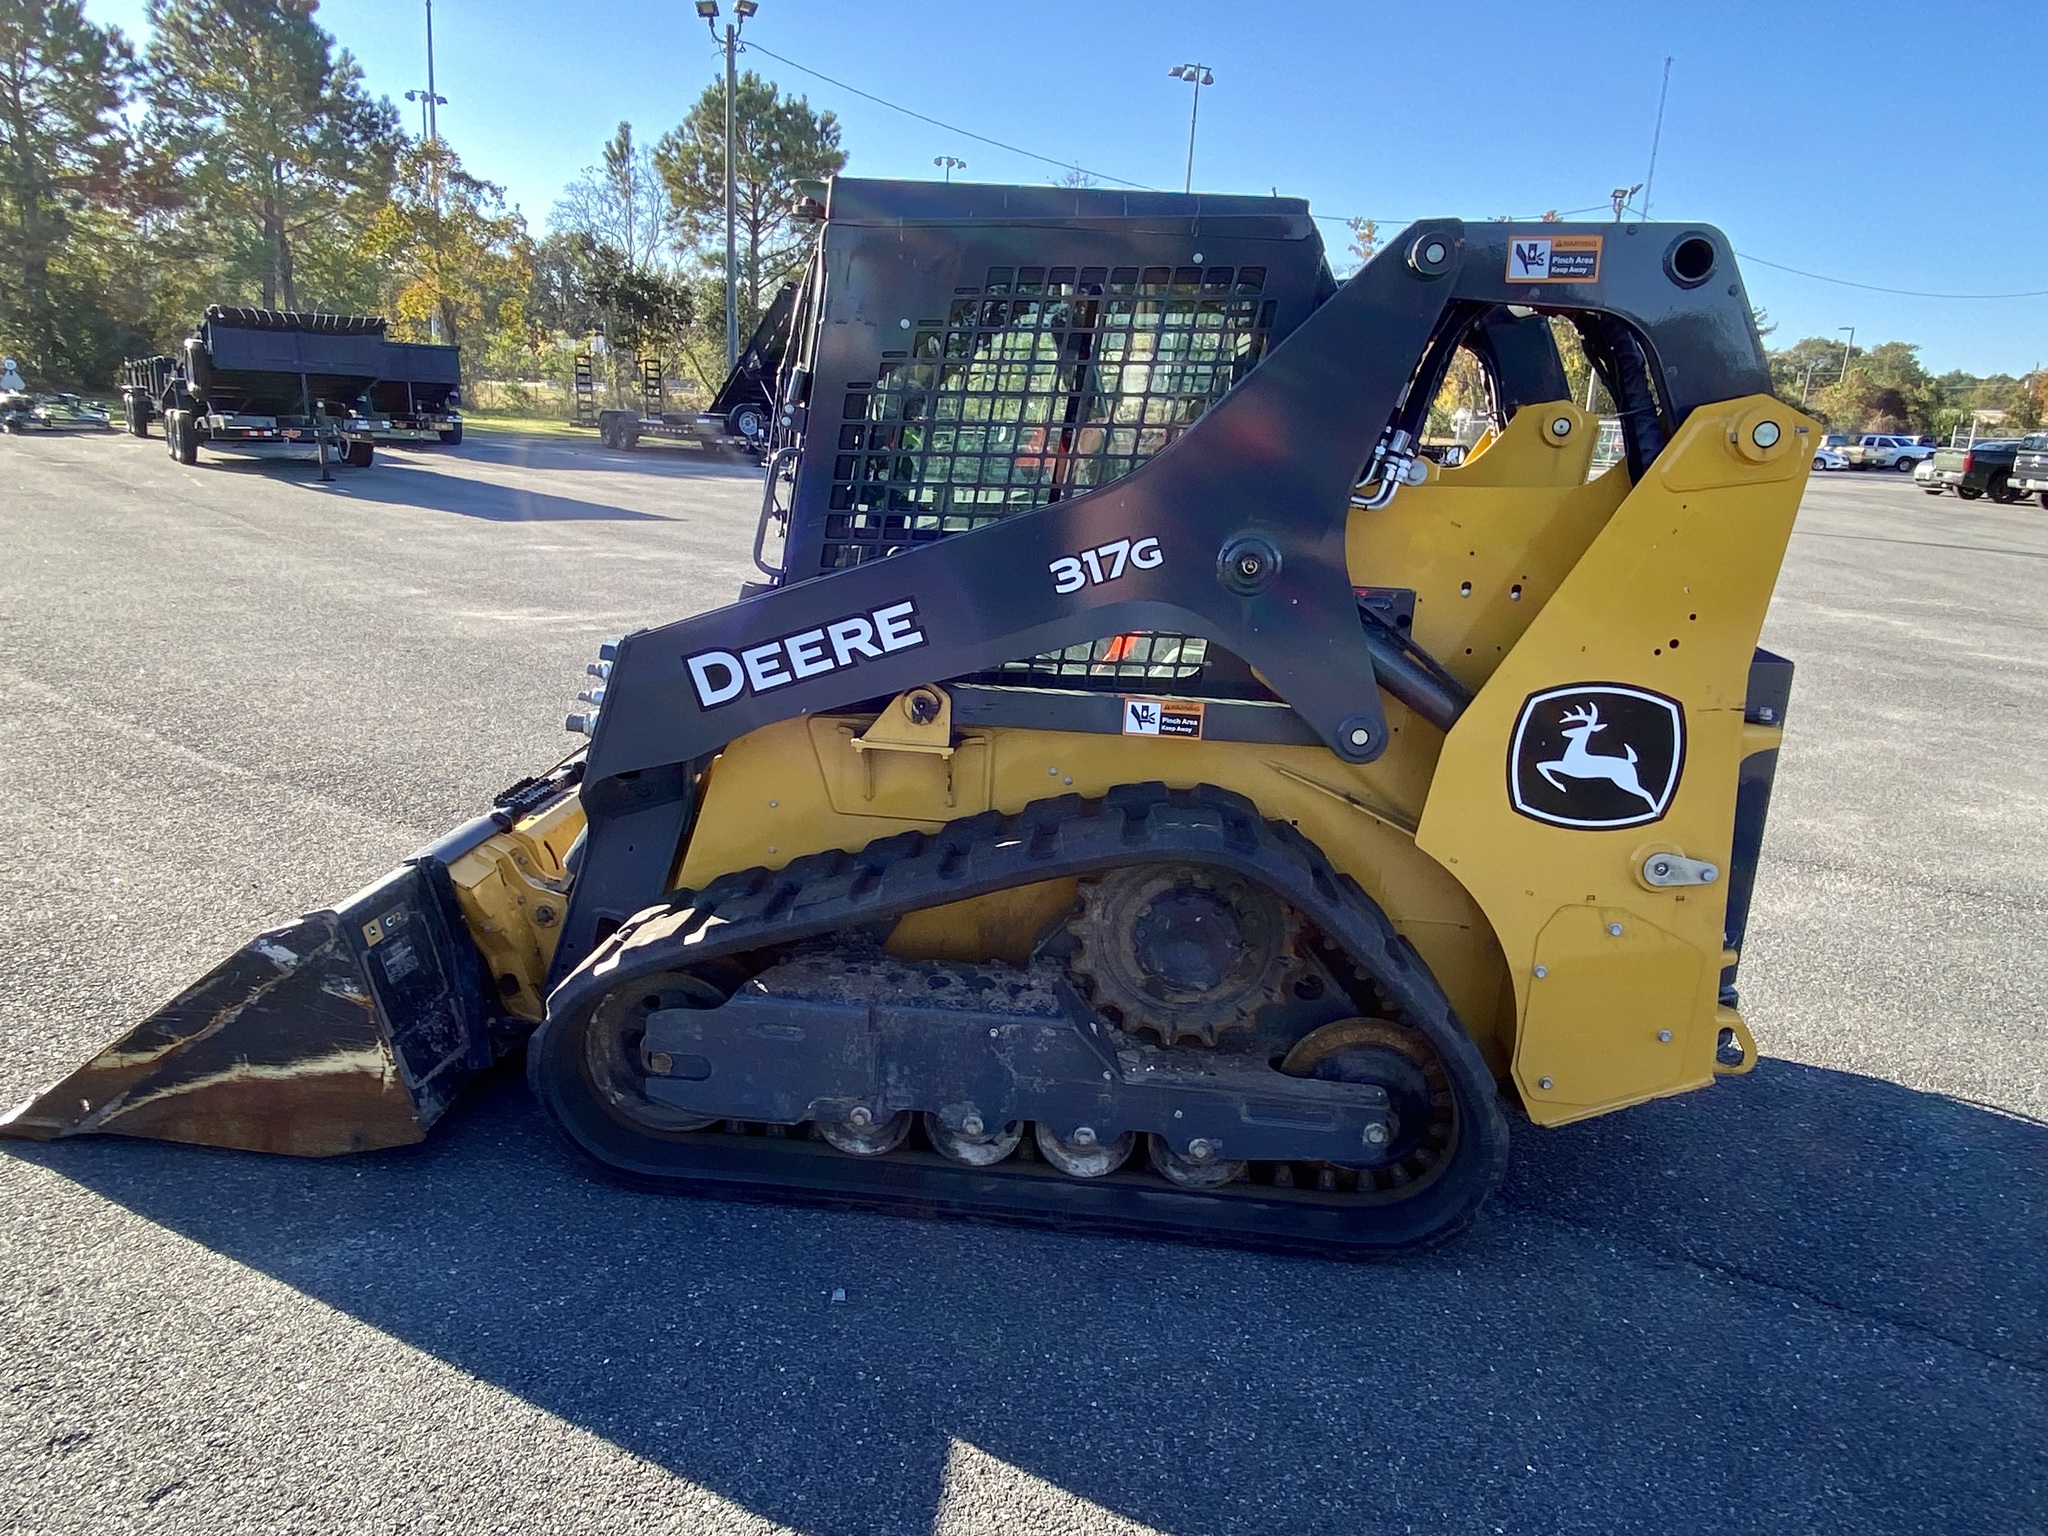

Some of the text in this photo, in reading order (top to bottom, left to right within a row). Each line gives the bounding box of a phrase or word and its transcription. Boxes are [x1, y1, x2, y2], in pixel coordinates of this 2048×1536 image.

[1552, 256, 1594, 264] Pinch Area
[1551, 266, 1588, 274] Keep Away
[1049, 537, 1163, 593] 317G
[687, 601, 923, 707] DEERE
[1181, 718, 1198, 726] Area
[1176, 726, 1192, 734] Away
